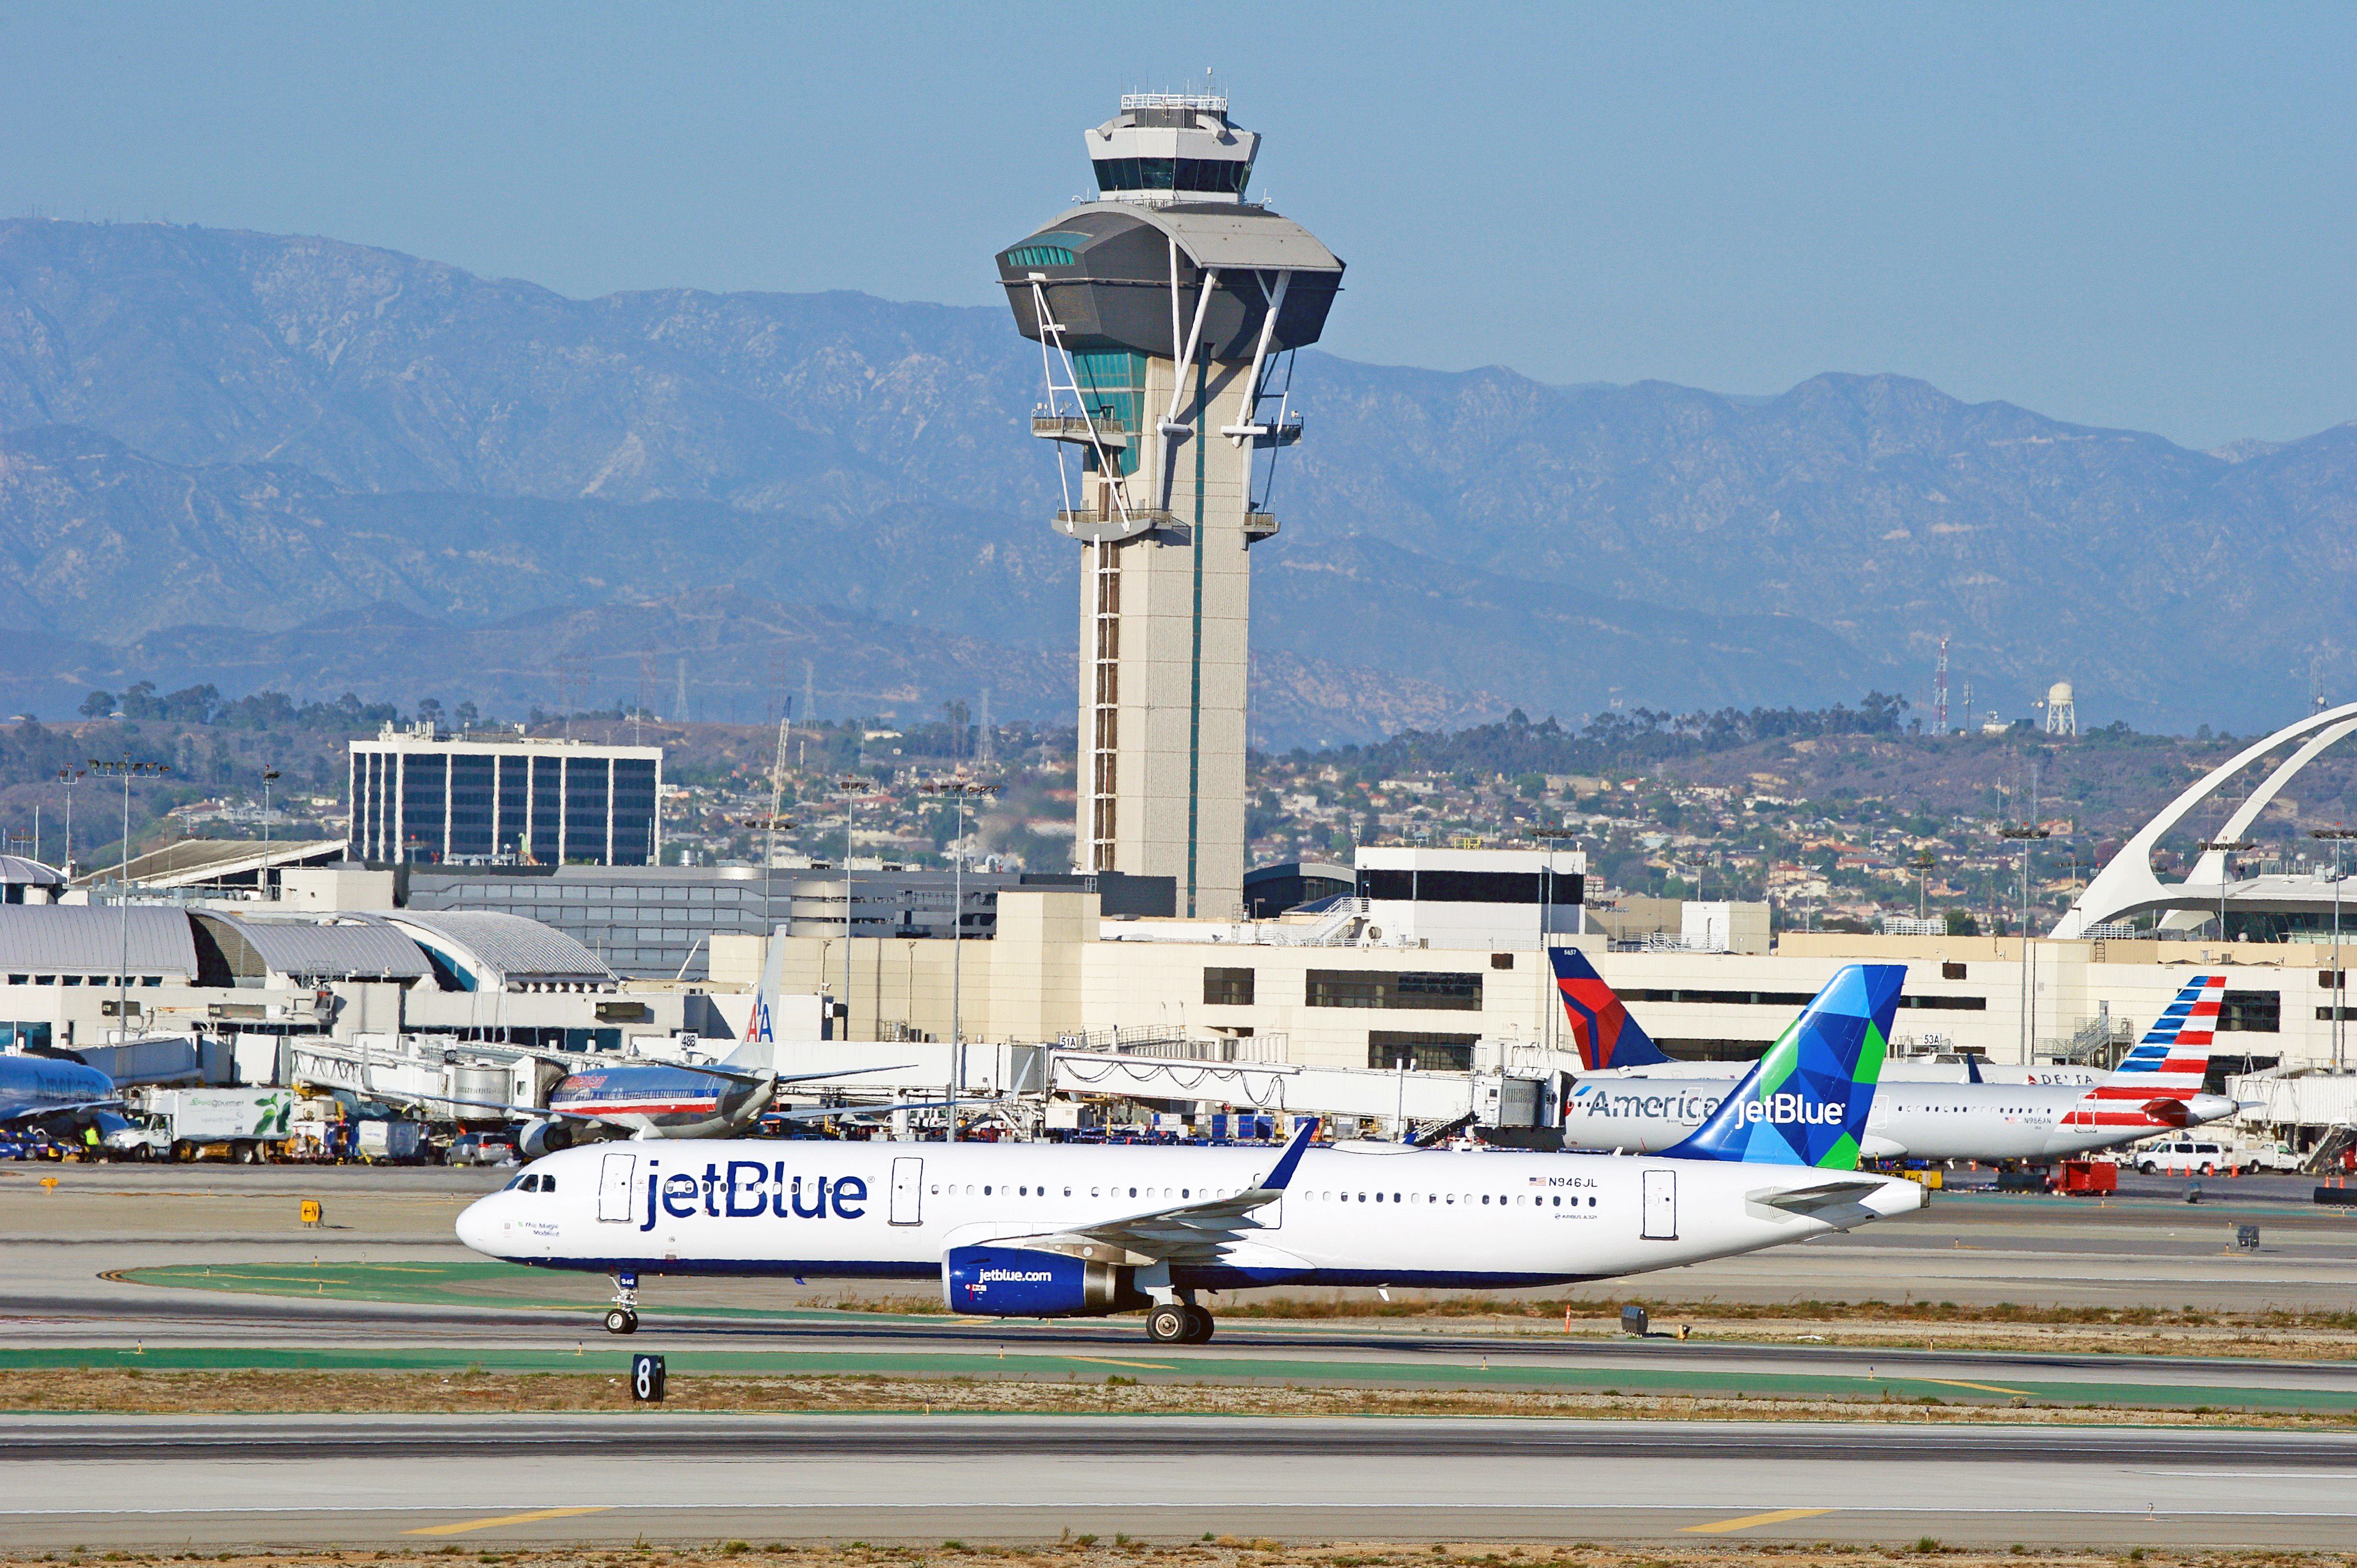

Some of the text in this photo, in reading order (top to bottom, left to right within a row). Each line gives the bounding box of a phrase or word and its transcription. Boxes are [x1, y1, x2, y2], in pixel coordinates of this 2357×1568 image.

[746, 1004, 774, 1043] AA
[682, 1035, 695, 1047] 48B
[1061, 1037, 1075, 1047] 51A
[1924, 1035, 1939, 1044] 53A
[2041, 1074, 2093, 1084] DETA
[1588, 1090, 1727, 1118] America
[1735, 1092, 1843, 1129] jetBlue
[1549, 1177, 1597, 1187] N946JL
[640, 1160, 867, 1232] jetBlue
[979, 1268, 1051, 1284] jetblue.com
[637, 1358, 651, 1399] 8
